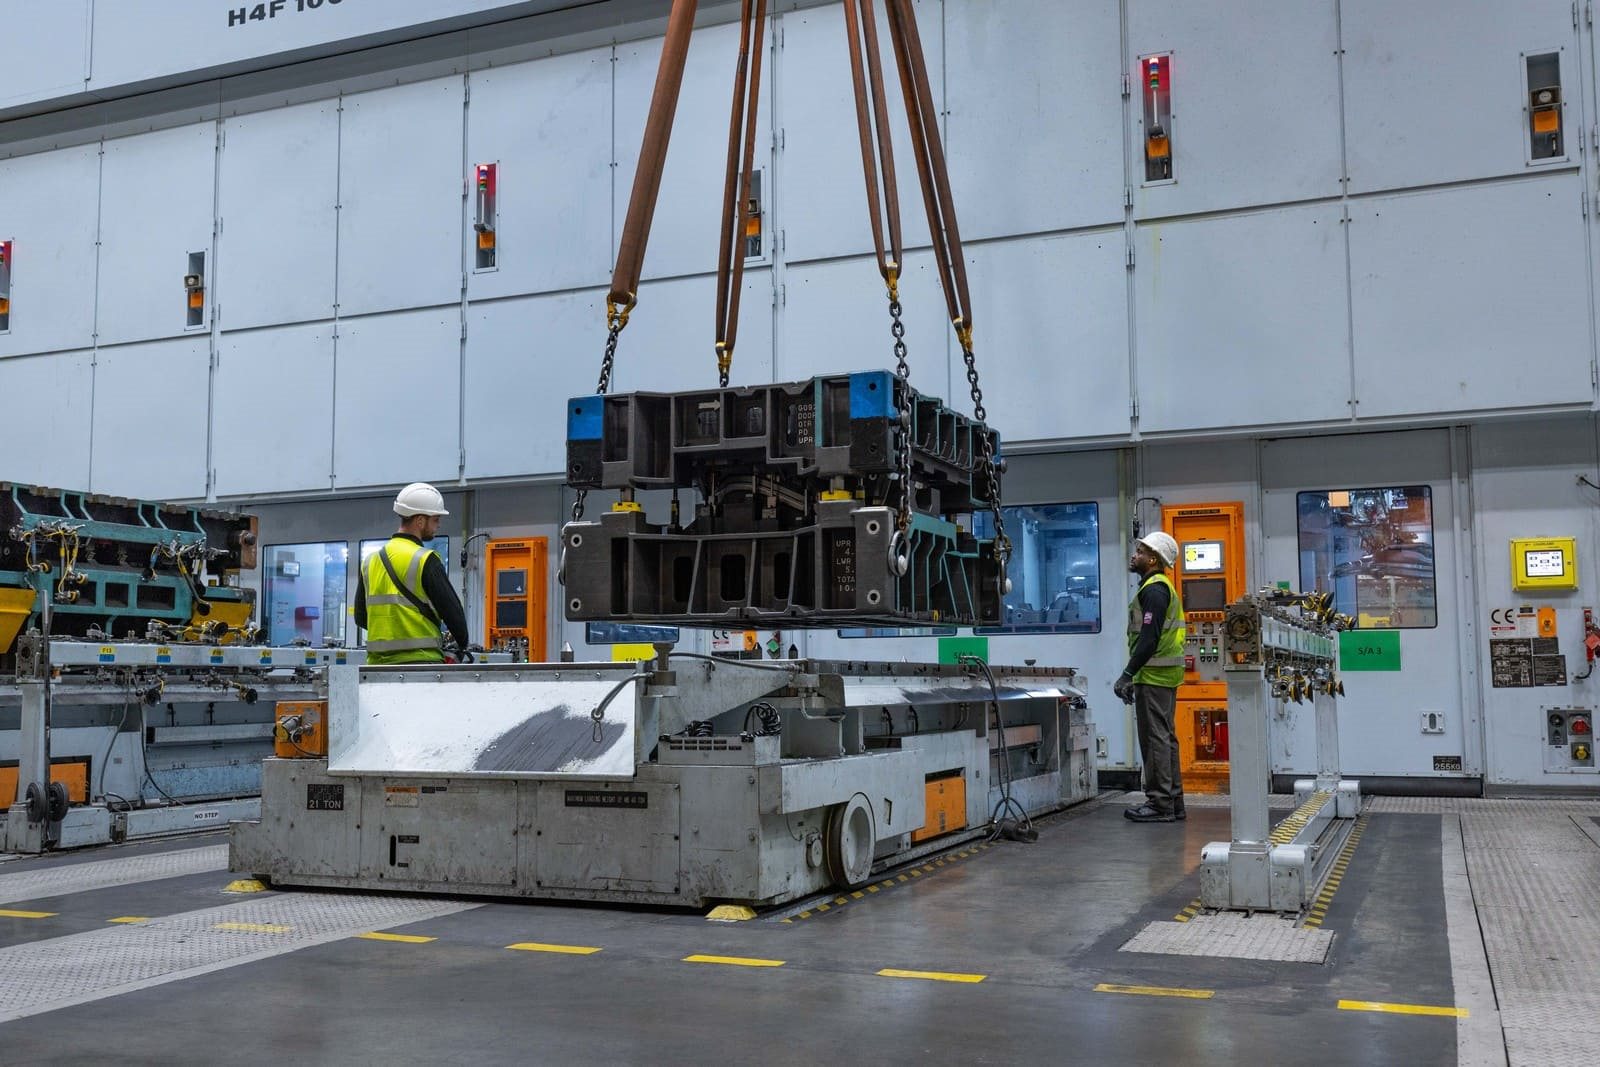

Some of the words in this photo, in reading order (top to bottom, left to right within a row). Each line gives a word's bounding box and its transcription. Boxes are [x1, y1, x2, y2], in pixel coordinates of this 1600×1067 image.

[228, 0, 286, 27] H4F
[297, 0, 342, 12] 10
[1357, 647, 1375, 656] S/A
[1376, 647, 1382, 655] 3
[309, 800, 319, 809] 21
[324, 800, 341, 809] TON
